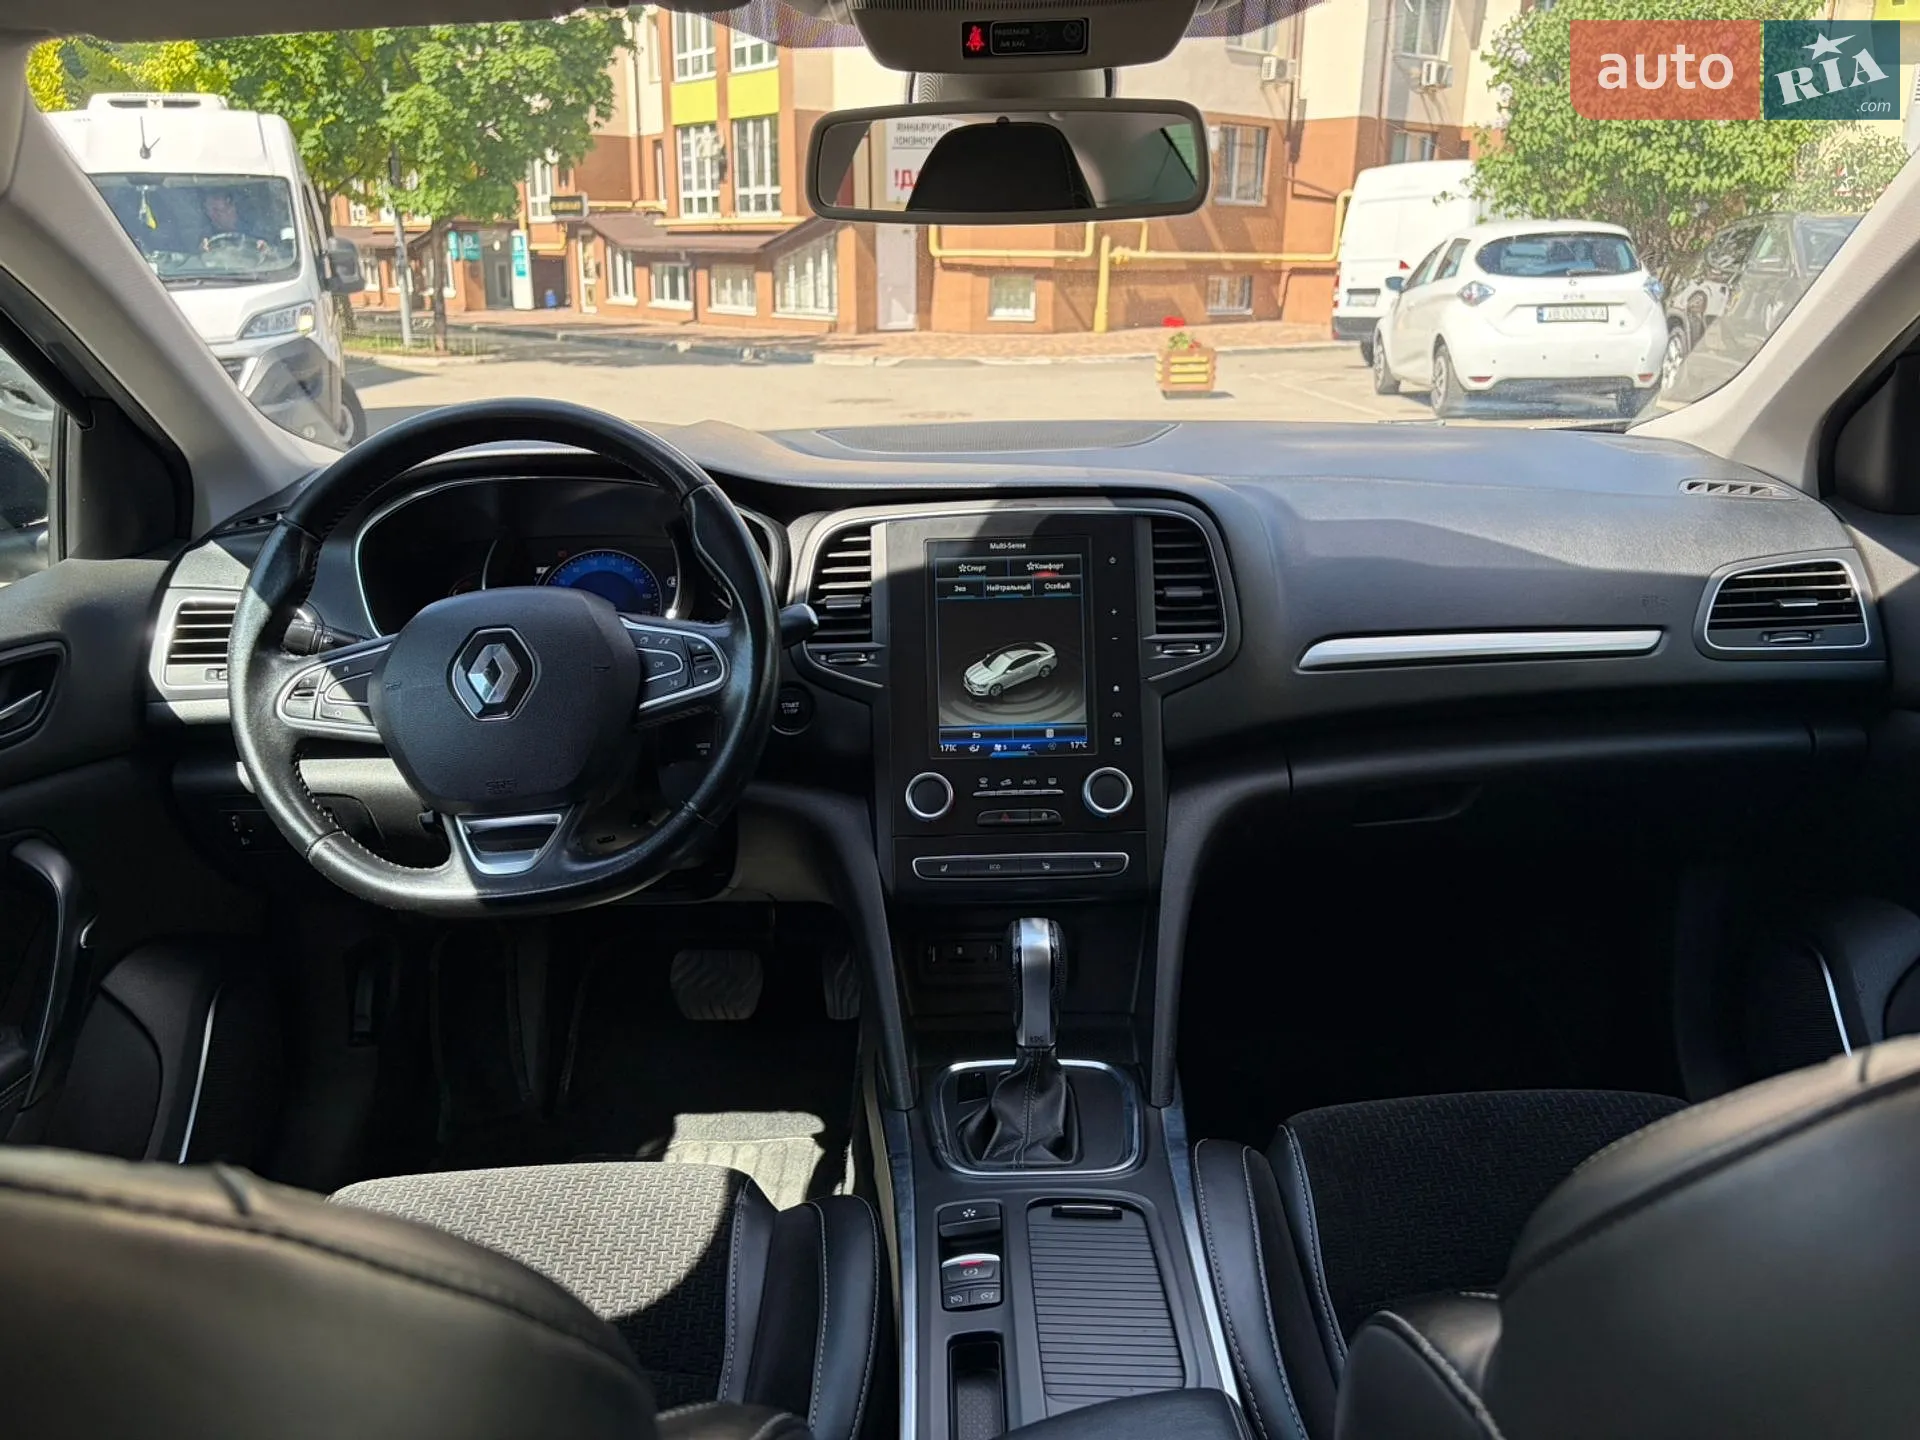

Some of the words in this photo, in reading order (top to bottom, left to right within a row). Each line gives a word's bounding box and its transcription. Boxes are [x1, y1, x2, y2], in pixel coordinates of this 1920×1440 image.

[989, 542, 1027, 550] Multi-Sense
[966, 564, 987, 573] Спорт
[1034, 562, 1064, 571] Комфорт
[986, 583, 1032, 593] Нейтральный
[1044, 582, 1071, 591] Особый
